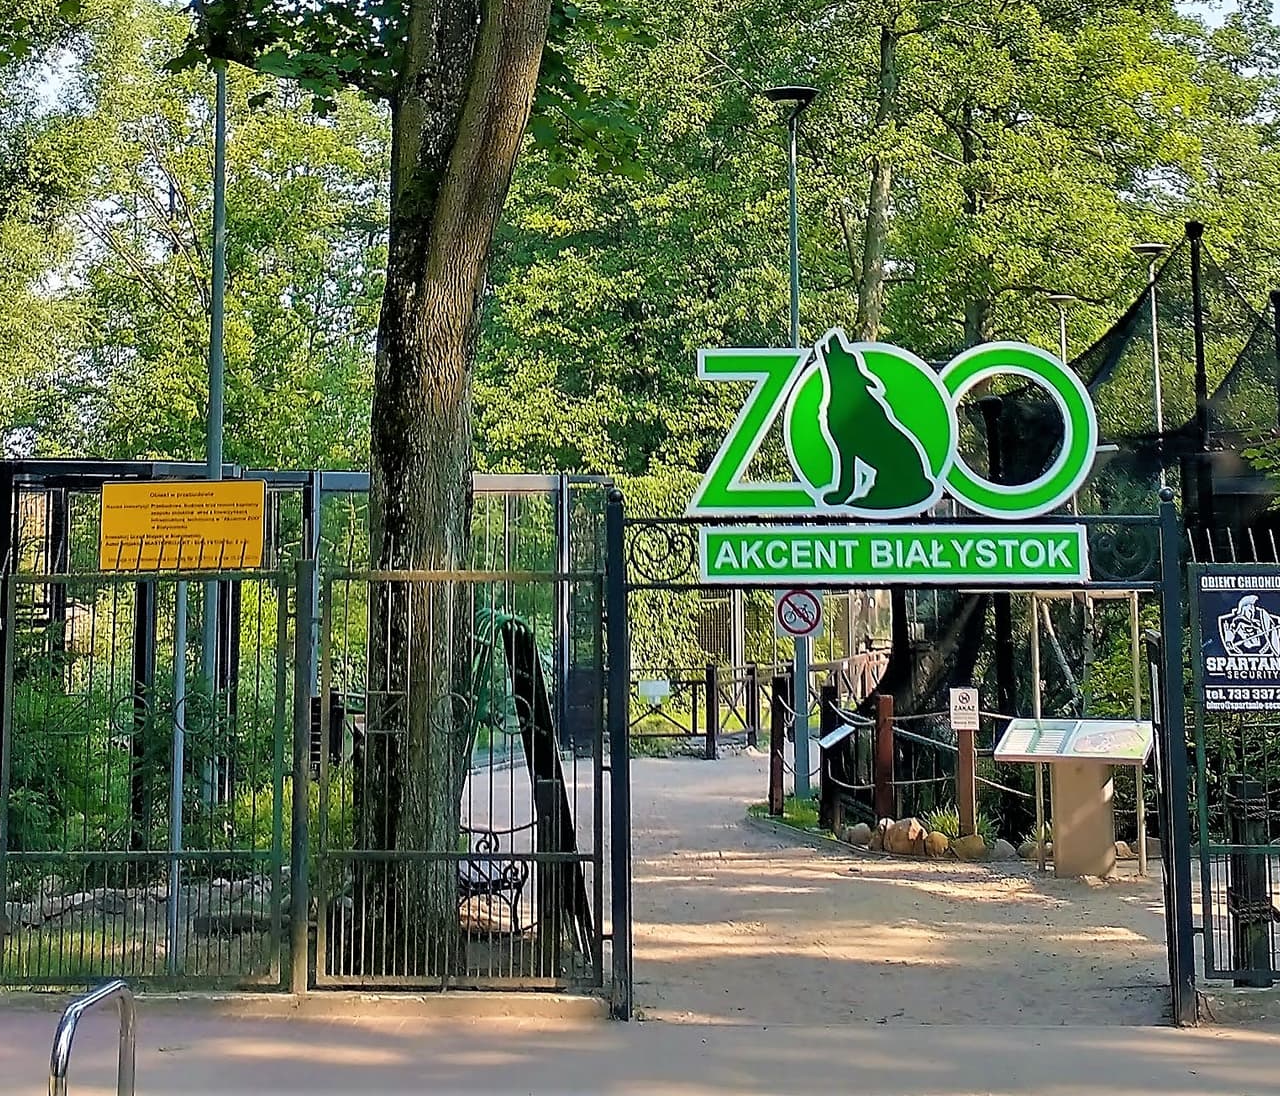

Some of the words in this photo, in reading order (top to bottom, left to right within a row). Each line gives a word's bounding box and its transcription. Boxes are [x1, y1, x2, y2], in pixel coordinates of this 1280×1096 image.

[687, 340, 1100, 519] ZOO
[714, 539, 860, 569] AKCENT
[870, 539, 1073, 569] BIAŁYSTOK
[1201, 576, 1236, 588] OBIEKT
[1227, 670, 1279, 680] SECURITY
[1205, 688, 1226, 700] tel.
[1227, 688, 1251, 700] 733
[1251, 688, 1275, 700] 337
